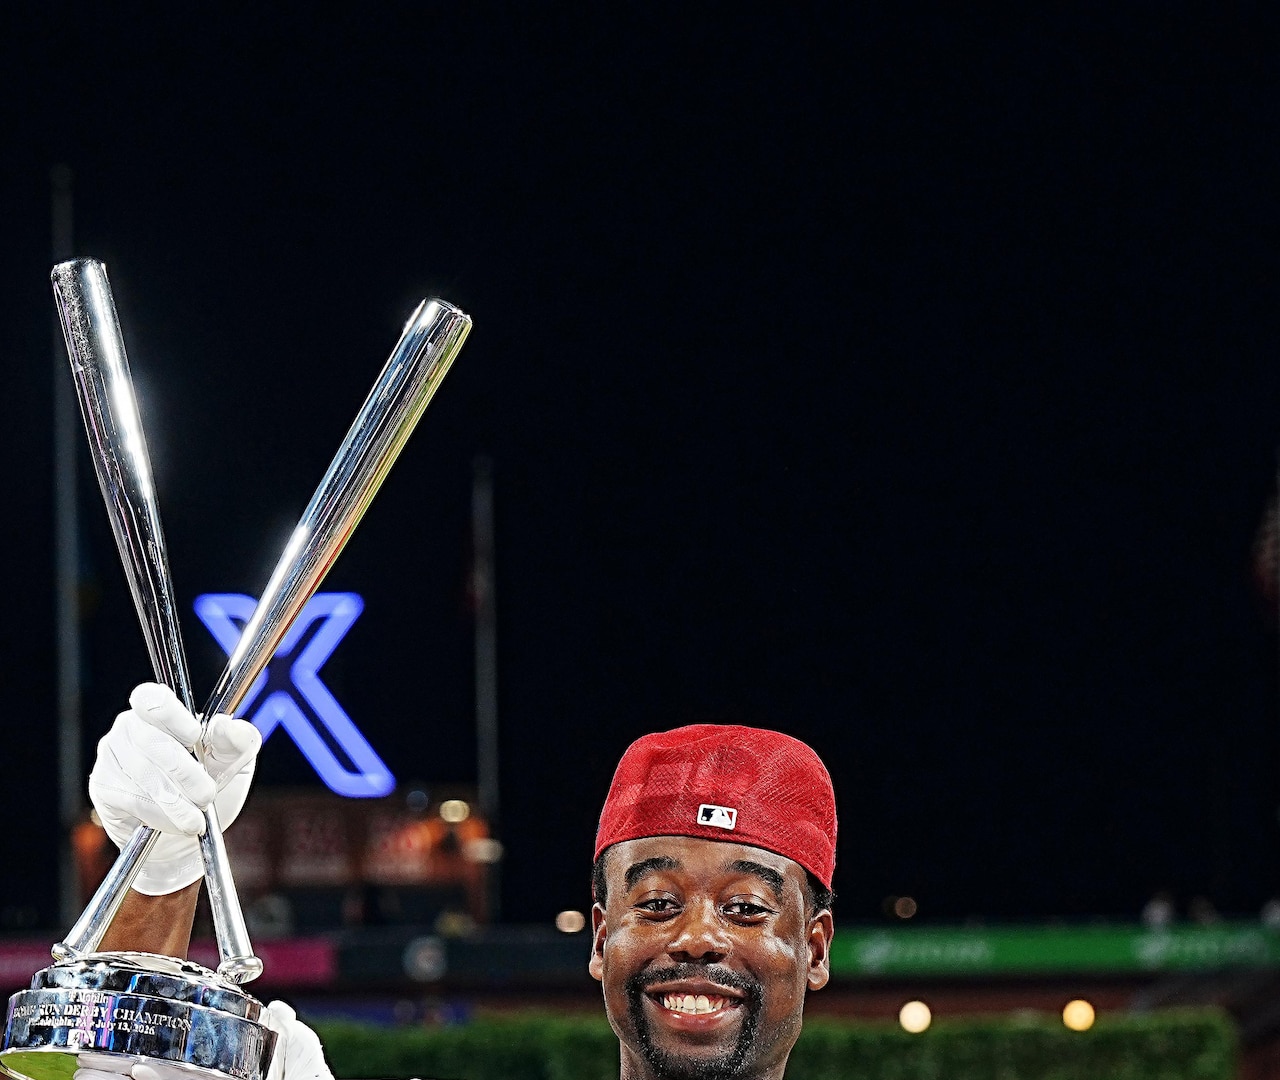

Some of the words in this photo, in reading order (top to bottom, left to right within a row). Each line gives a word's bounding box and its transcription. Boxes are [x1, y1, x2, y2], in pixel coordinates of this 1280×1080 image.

[63, 1004, 110, 1019] DERBY
[113, 1007, 193, 1032] CHAMPION
[117, 1022, 130, 1033] 13,
[131, 1023, 156, 1036] 2026
